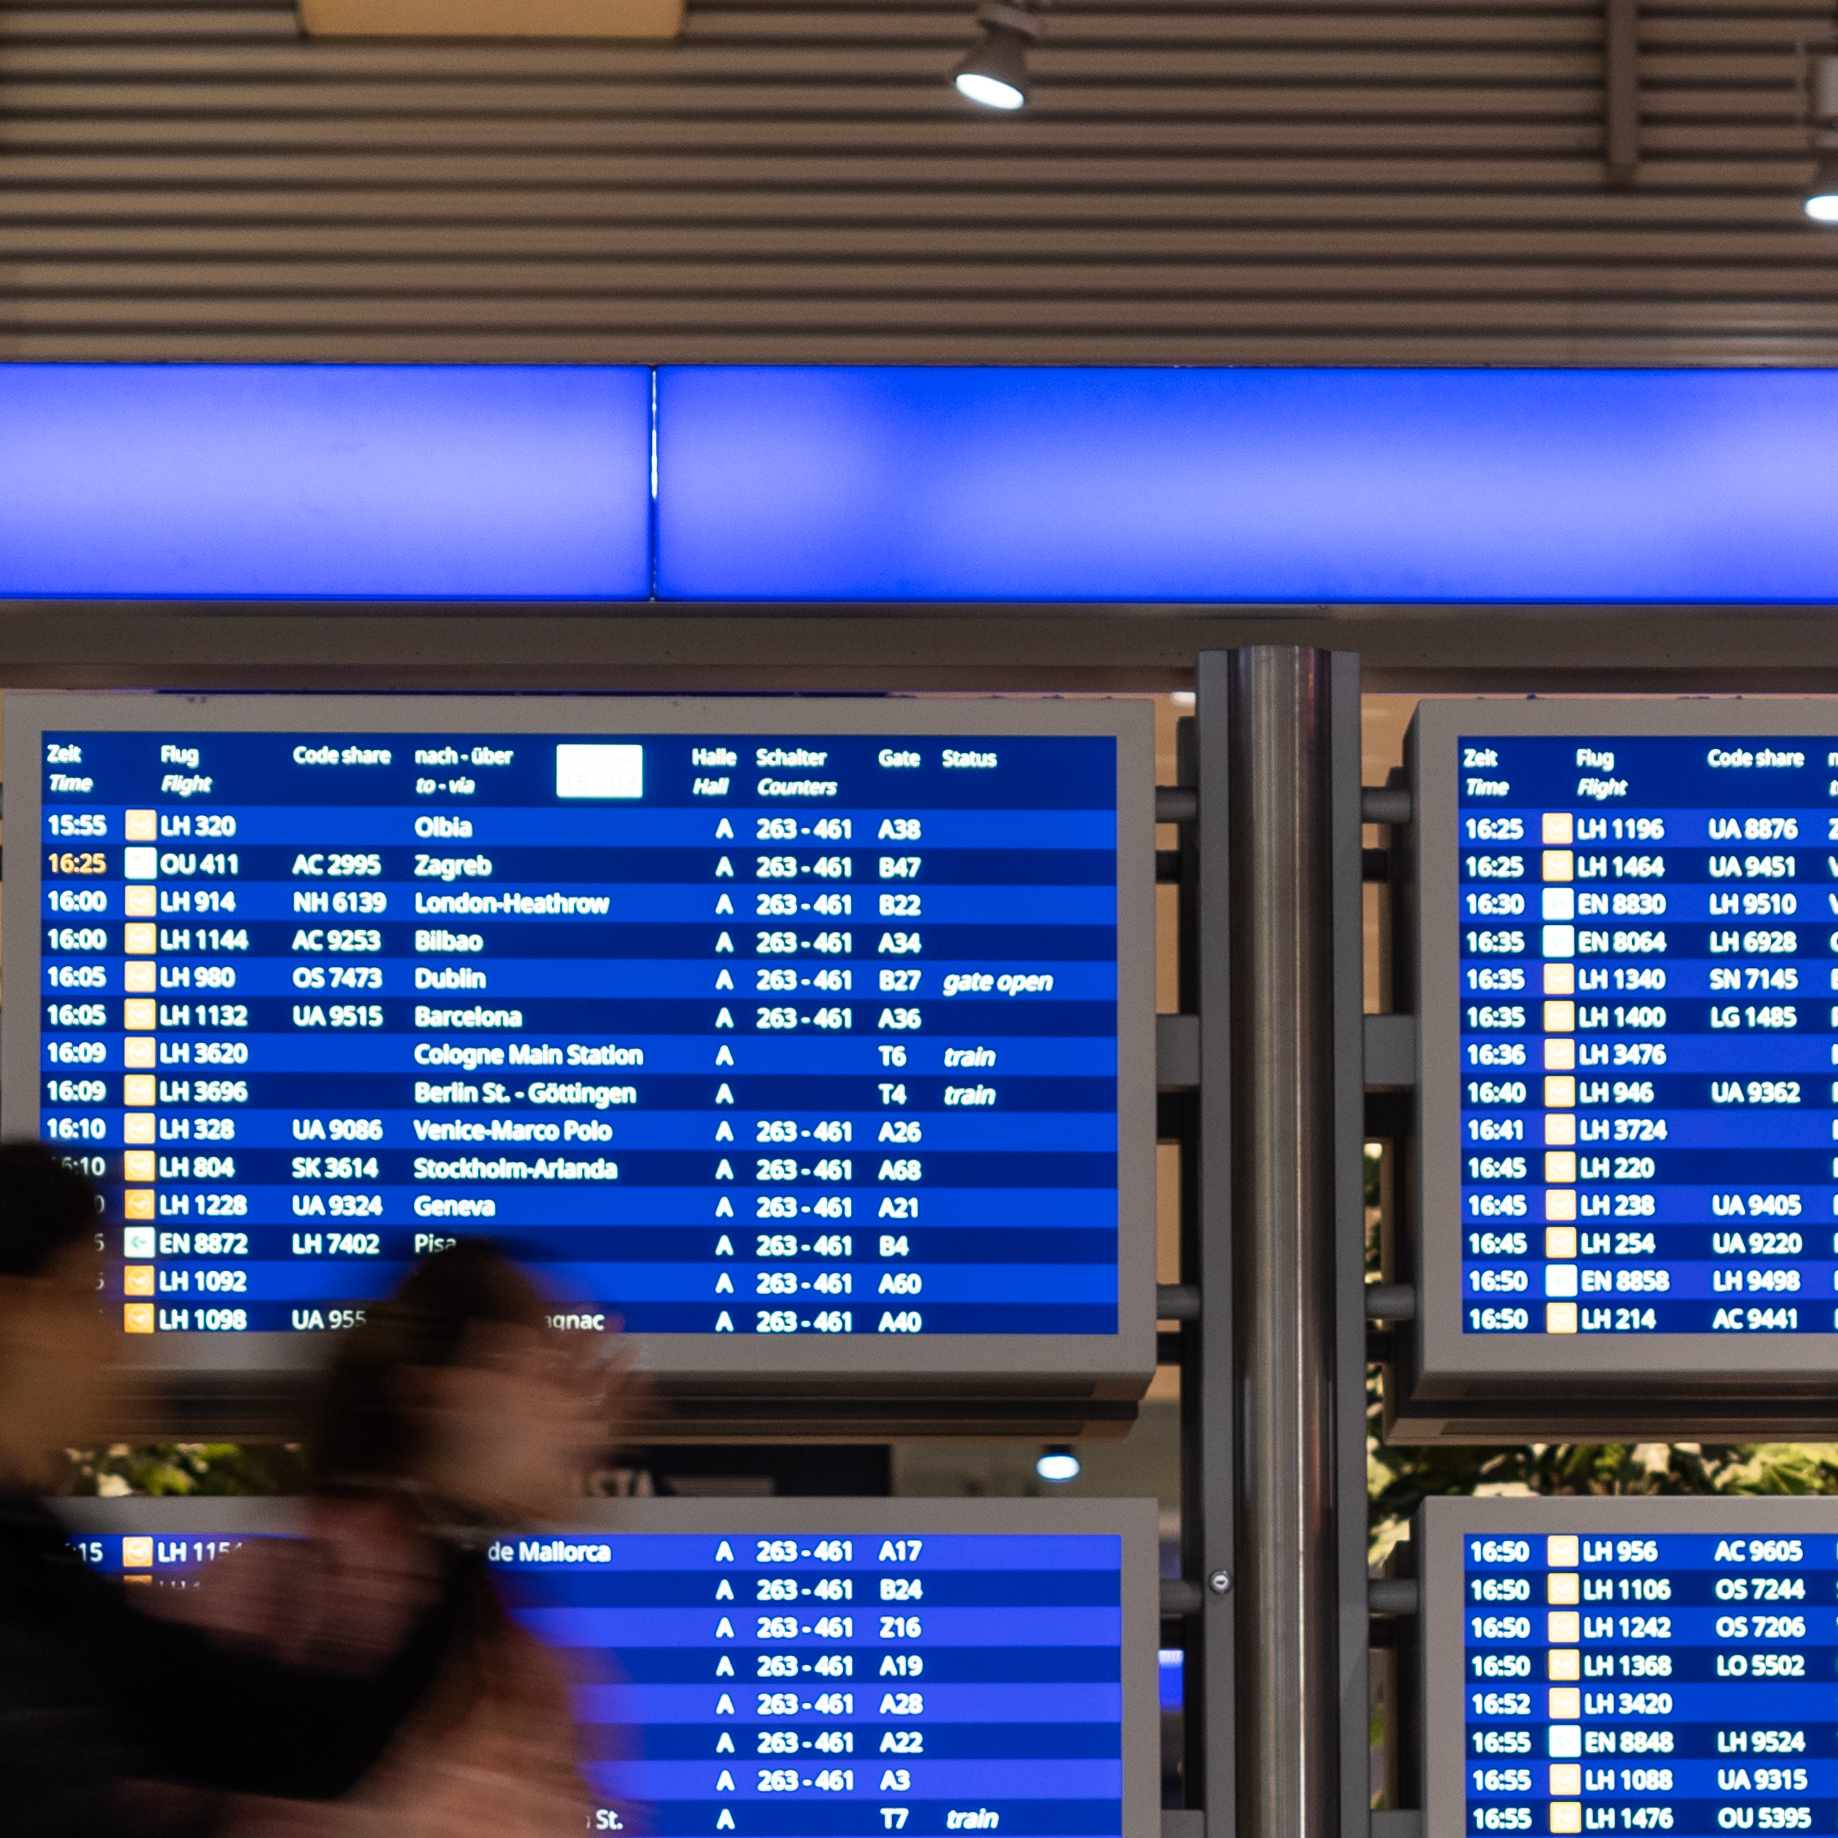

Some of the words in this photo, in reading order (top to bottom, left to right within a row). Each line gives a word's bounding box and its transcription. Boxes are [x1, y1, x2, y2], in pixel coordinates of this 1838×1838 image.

[48, 814, 107, 836] 15:55
[161, 815, 191, 836] LH
[194, 815, 236, 837] 320
[414, 816, 473, 838] Olbia
[877, 818, 921, 840] A38
[1465, 818, 1524, 840] 16:25
[1577, 818, 1607, 840] LH
[1612, 818, 1665, 840] 1196
[1709, 818, 1743, 840] UA
[1744, 817, 1799, 840] 8876
[48, 852, 107, 874] 16:25
[414, 854, 492, 881] Zagreb
[293, 891, 329, 913] NH
[332, 891, 387, 913] 6139
[415, 891, 610, 914] London-Heathrow
[415, 929, 484, 952] Bilbao
[415, 967, 486, 989] Dublin
[415, 1005, 523, 1027] Barcelona
[414, 1043, 505, 1071] Cologne
[509, 1043, 563, 1065] Main
[566, 1044, 644, 1065] Station
[878, 1045, 907, 1067] T6
[944, 1046, 996, 1067] train
[413, 1119, 560, 1141] Venice-Marco
[564, 1119, 613, 1141] Polo
[414, 1157, 618, 1179] Stockholm-Arlanda
[413, 1195, 496, 1217] Geneva
[488, 1541, 514, 1562] de
[519, 1540, 612, 1563] Mallorca
[878, 1540, 923, 1562] A17
[1470, 1540, 1530, 1563] 16:50
[1583, 1540, 1613, 1562] LH
[1616, 1540, 1659, 1562] 956
[1714, 1540, 1746, 1562] AC
[1749, 1540, 1804, 1562] 9605
[880, 1578, 923, 1600] B24
[879, 1616, 922, 1639] Z16
[880, 1807, 909, 1829] T7
[946, 1807, 999, 1829] train
